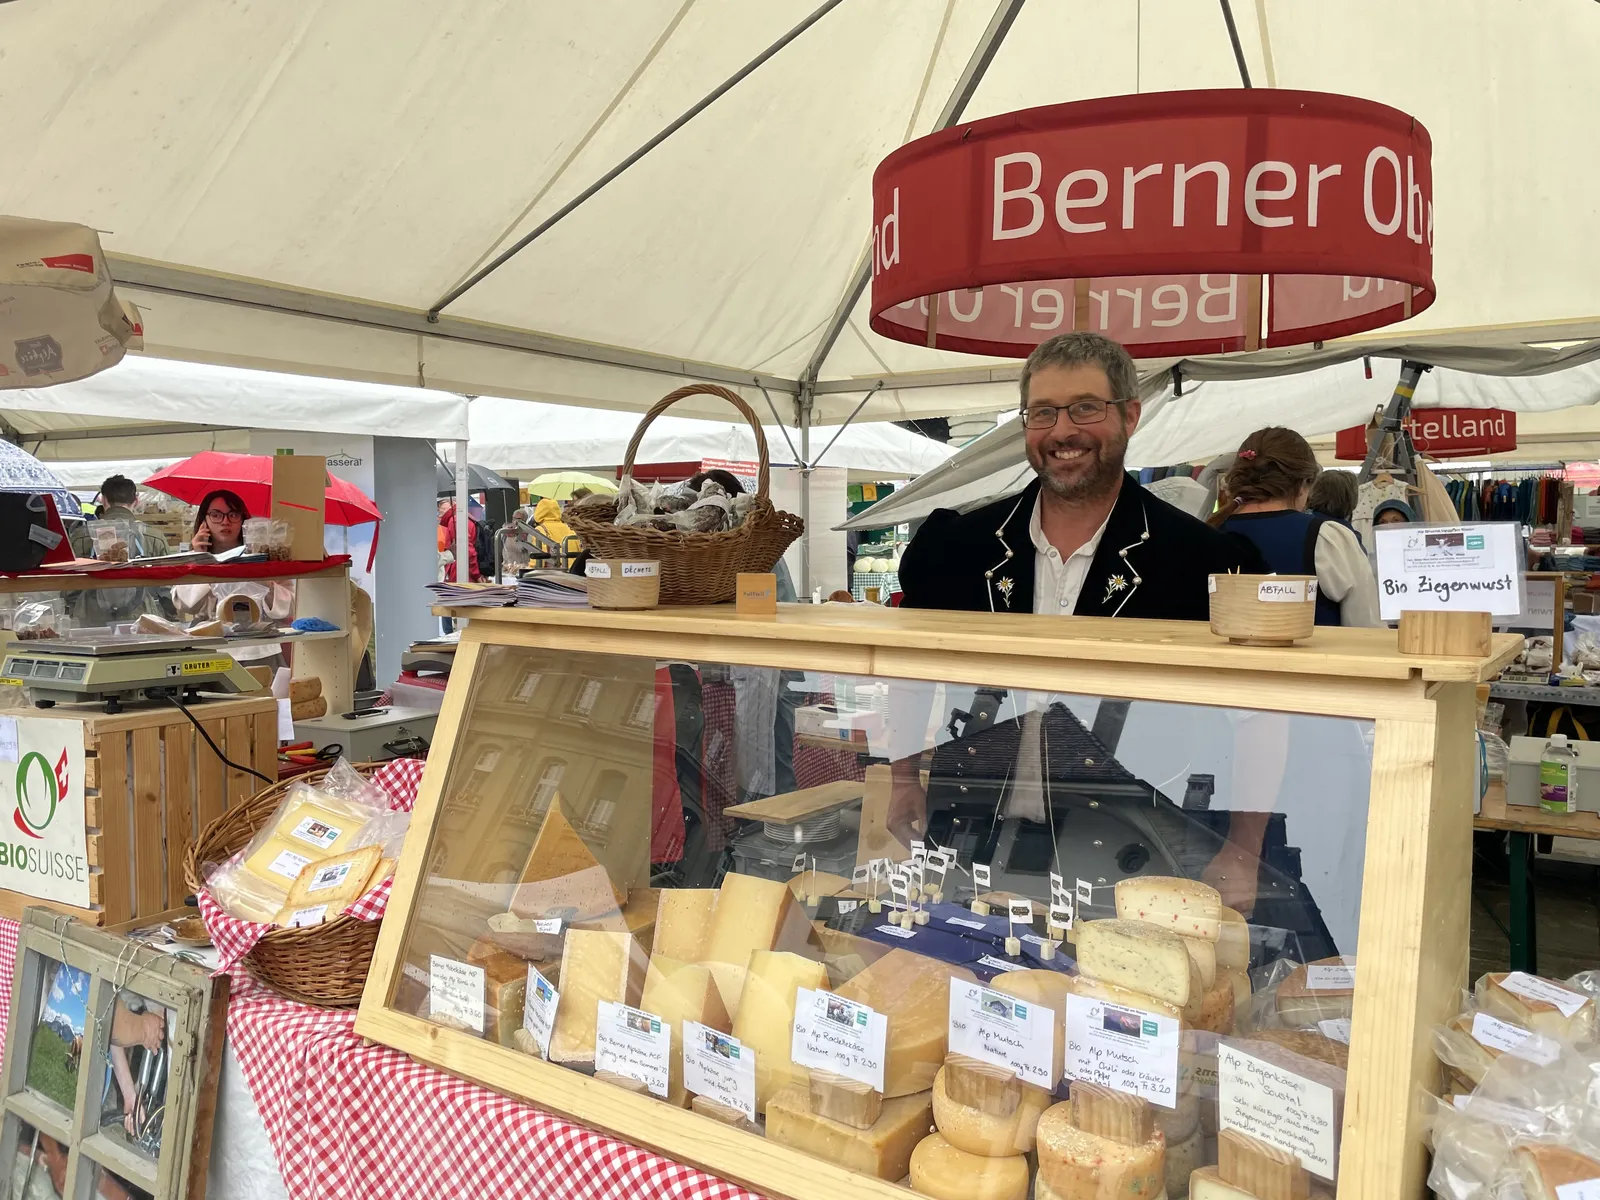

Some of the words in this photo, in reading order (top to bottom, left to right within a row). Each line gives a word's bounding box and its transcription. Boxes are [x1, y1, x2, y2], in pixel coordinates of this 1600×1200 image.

[992, 151, 1342, 241] Berner
[327, 458, 362, 467] asserat
[1260, 586, 1296, 595] ABFALL
[1383, 579, 1408, 595] Bio
[1418, 574, 1513, 602] Ziegenwurst
[796, 1023, 806, 1033] Bio
[952, 1020, 967, 1030] Bio
[598, 1033, 607, 1042] Bio
[609, 1037, 625, 1048] Berner
[978, 1027, 991, 1041] Alp
[993, 1032, 1025, 1049] Mutsch
[807, 1042, 829, 1056] Nature
[984, 1043, 1007, 1058] Nature
[1068, 1041, 1081, 1051] Bio
[1089, 1046, 1102, 1060] Alp
[1106, 1049, 1139, 1064] Mutsch
[1010, 1060, 1024, 1076] 100g
[1225, 1053, 1240, 1070] Alp
[1246, 1059, 1299, 1092] Ziegenkäse
[1122, 1069, 1136, 1077] oder
[1138, 1071, 1166, 1083] Kräuter
[1121, 1080, 1139, 1096] 100g
[1150, 1084, 1171, 1094] 3.20
